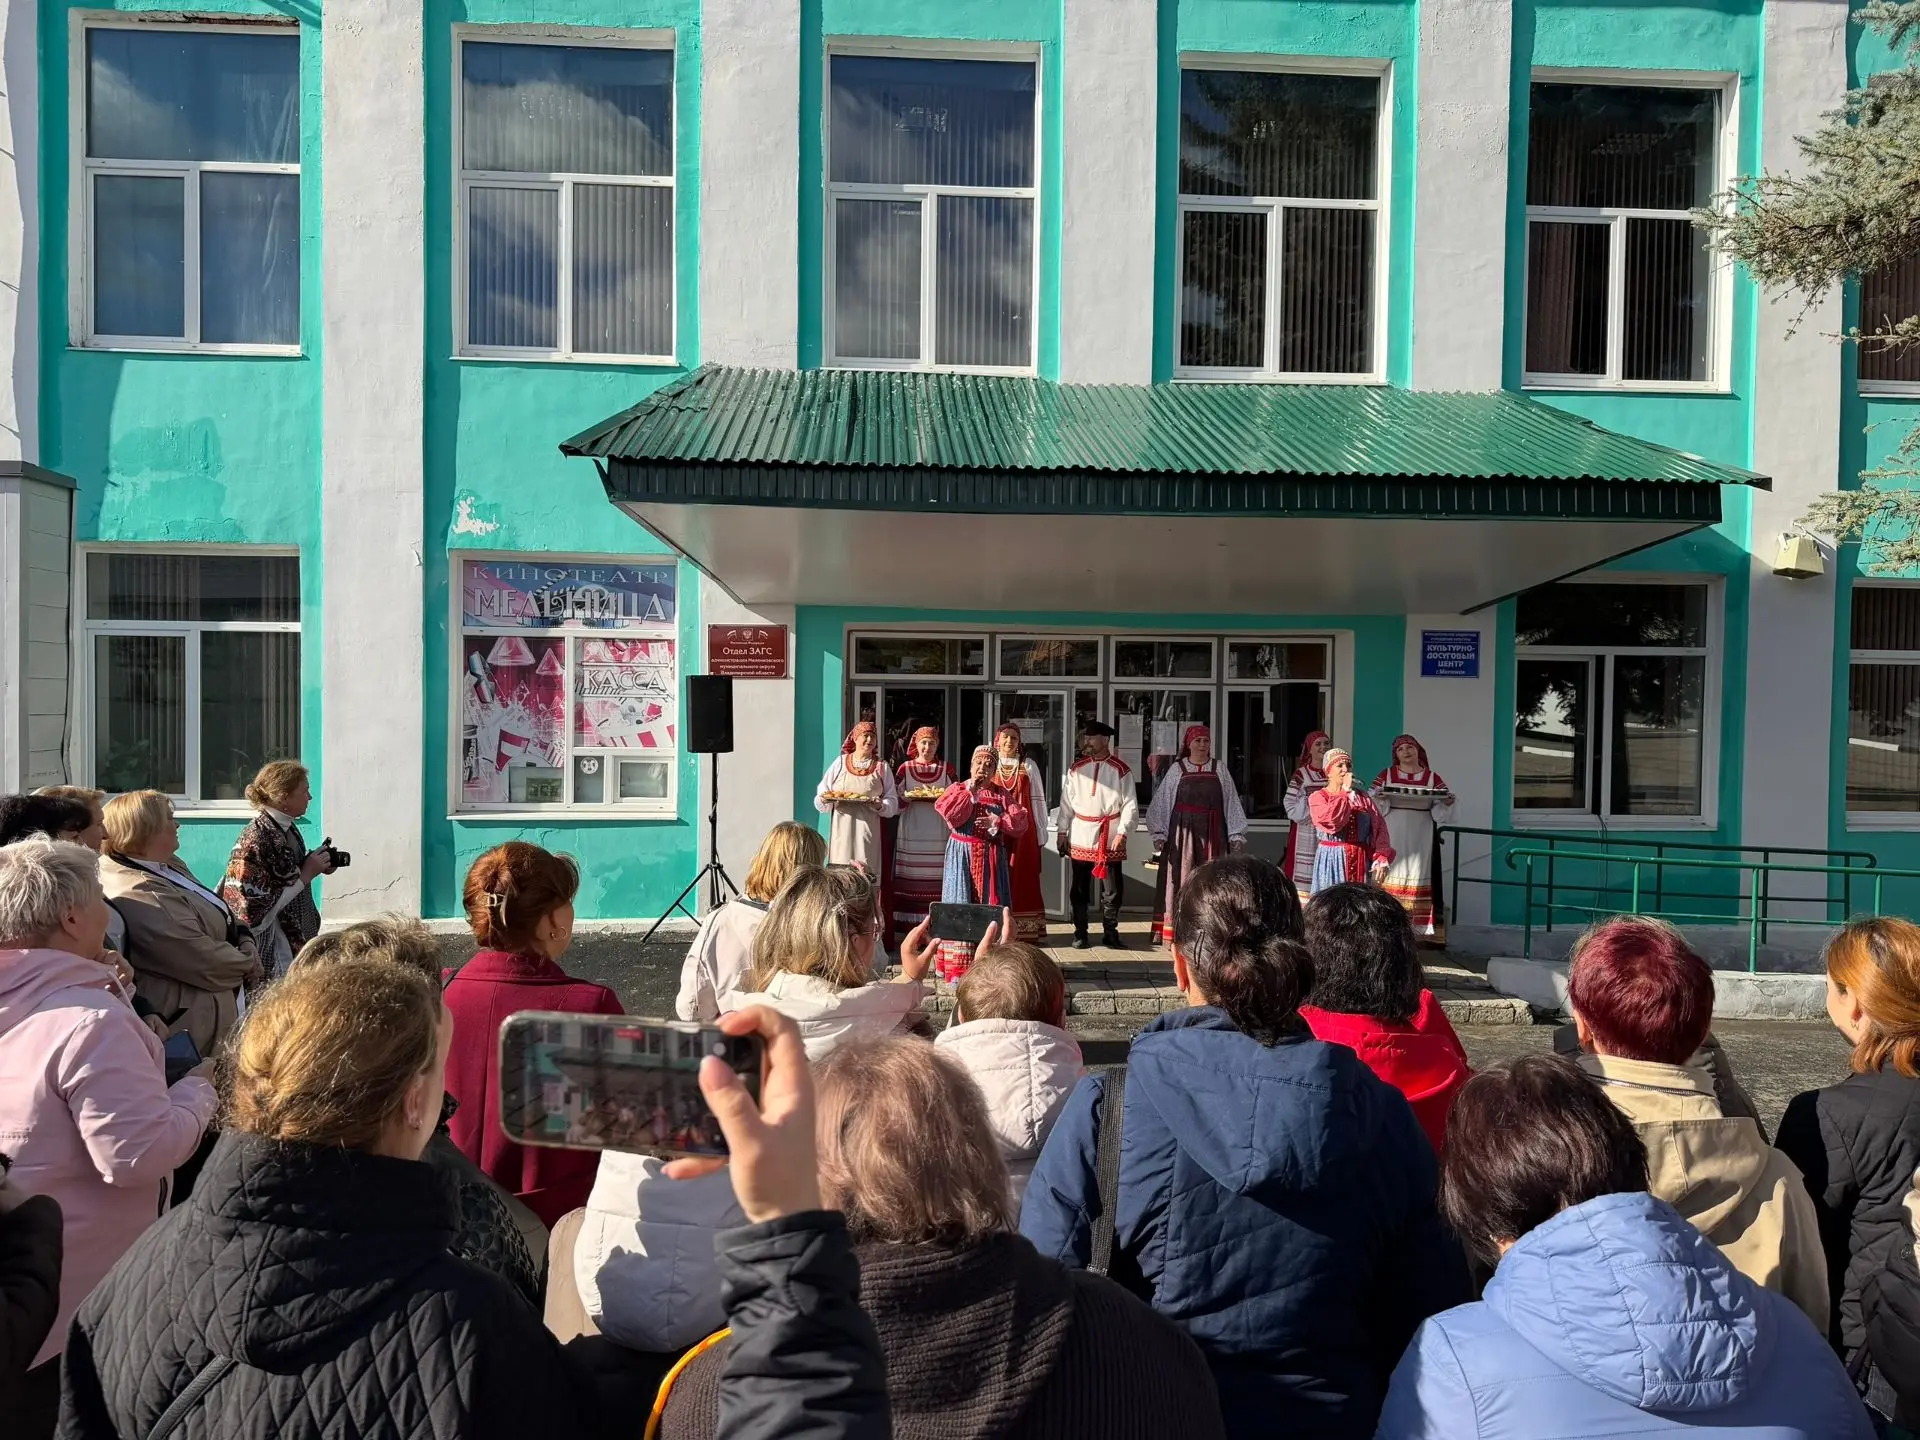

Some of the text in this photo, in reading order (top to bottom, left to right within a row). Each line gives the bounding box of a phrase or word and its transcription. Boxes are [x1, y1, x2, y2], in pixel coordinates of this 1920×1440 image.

[472, 566, 669, 584] КИНОТЕАТР
[474, 587, 666, 623] МЕЛЬНИЦА
[722, 647, 773, 655] Отдел ЗАГС
[1427, 644, 1476, 652] КУЛЬТУРНО-
[583, 670, 668, 690] КАССА
